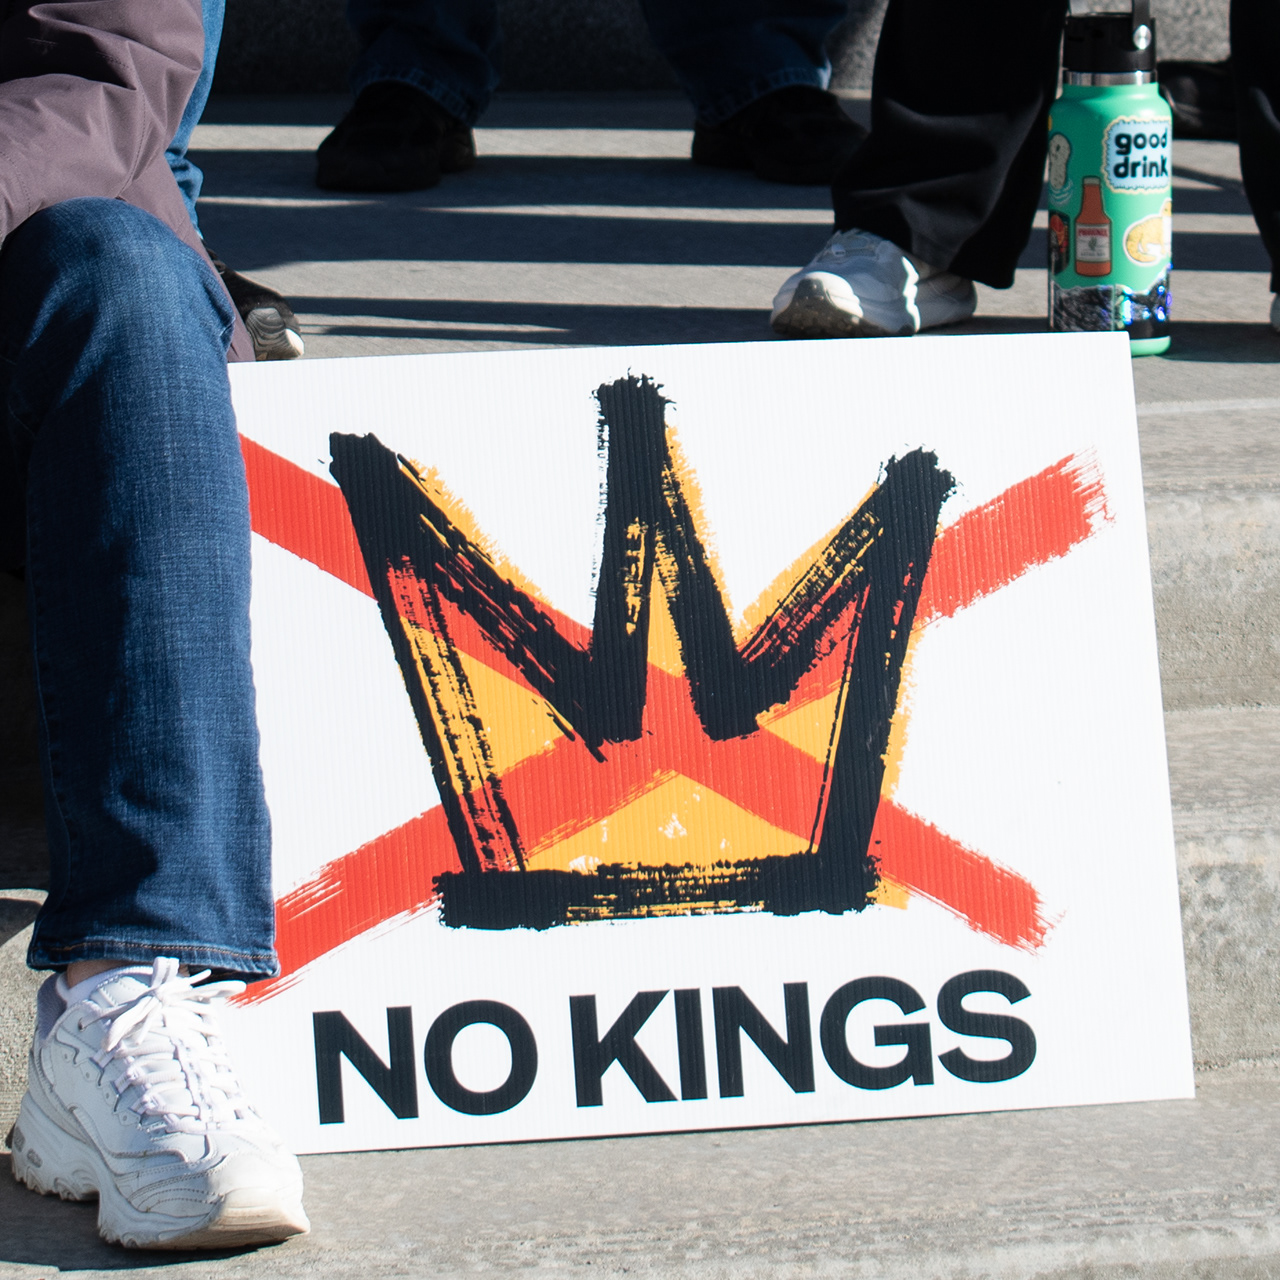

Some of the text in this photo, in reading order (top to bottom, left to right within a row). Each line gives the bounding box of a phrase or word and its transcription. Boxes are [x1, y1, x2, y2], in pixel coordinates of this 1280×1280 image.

[1114, 127, 1168, 155] good
[1113, 154, 1169, 179] drink
[312, 999, 539, 1125] NO
[569, 969, 1037, 1108] KINGS
